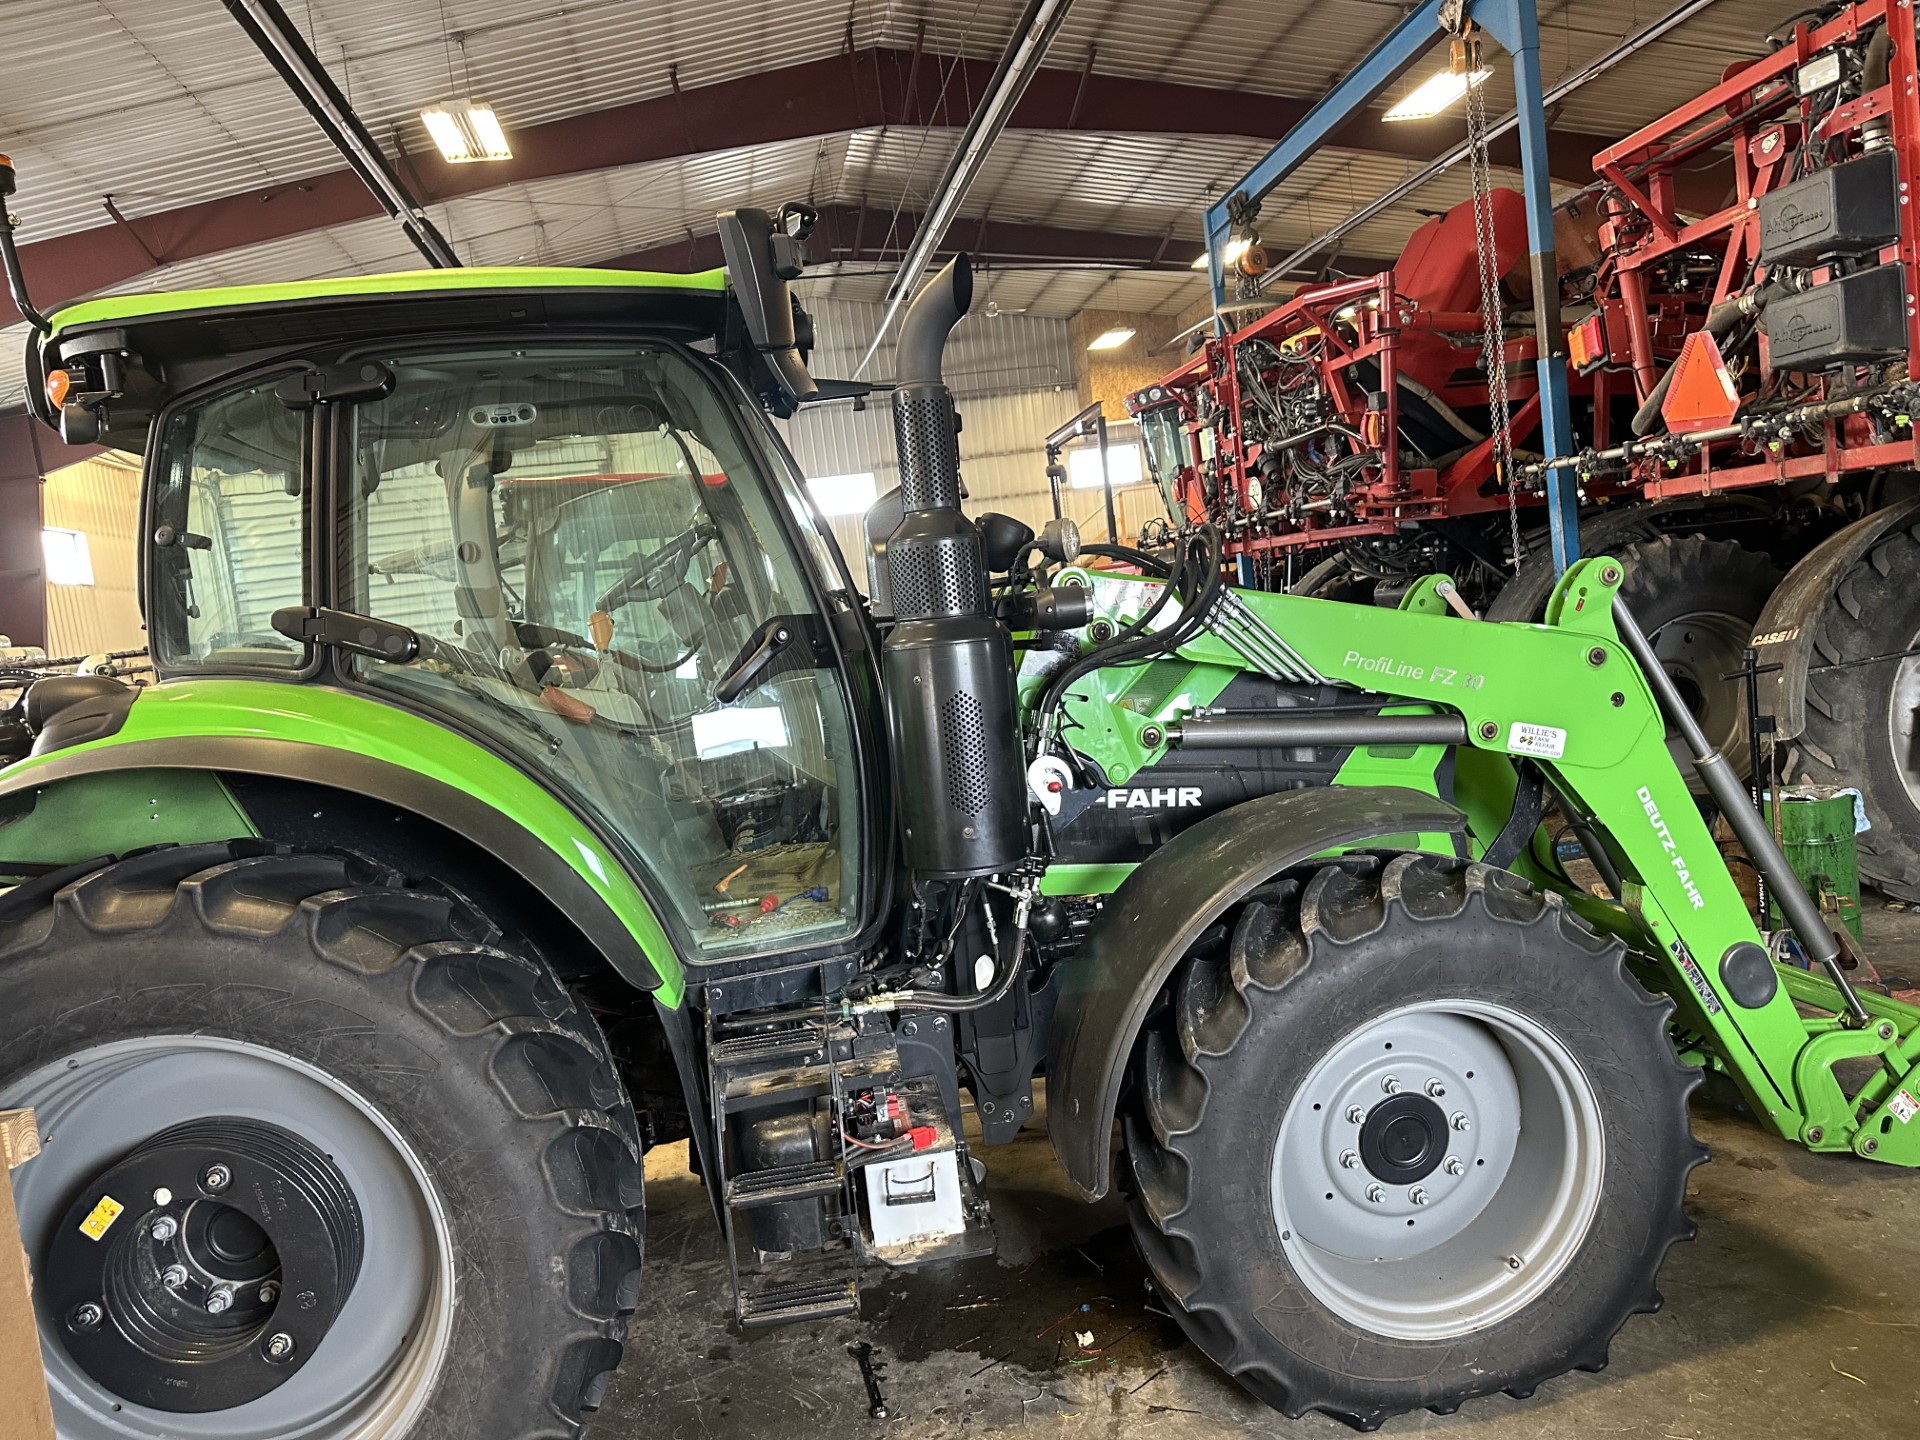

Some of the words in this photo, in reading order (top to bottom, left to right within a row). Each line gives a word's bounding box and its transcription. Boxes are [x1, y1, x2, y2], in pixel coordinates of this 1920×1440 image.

[1751, 630, 1788, 646] CASE
[1342, 650, 1424, 680] ProfiLine
[1429, 666, 1458, 686] FZ
[1521, 725, 1557, 739] WILLIE'S
[1534, 735, 1550, 743] FARM
[1534, 742, 1555, 750] REPAIR
[1635, 785, 1705, 911] DEUTZ-FAHR
